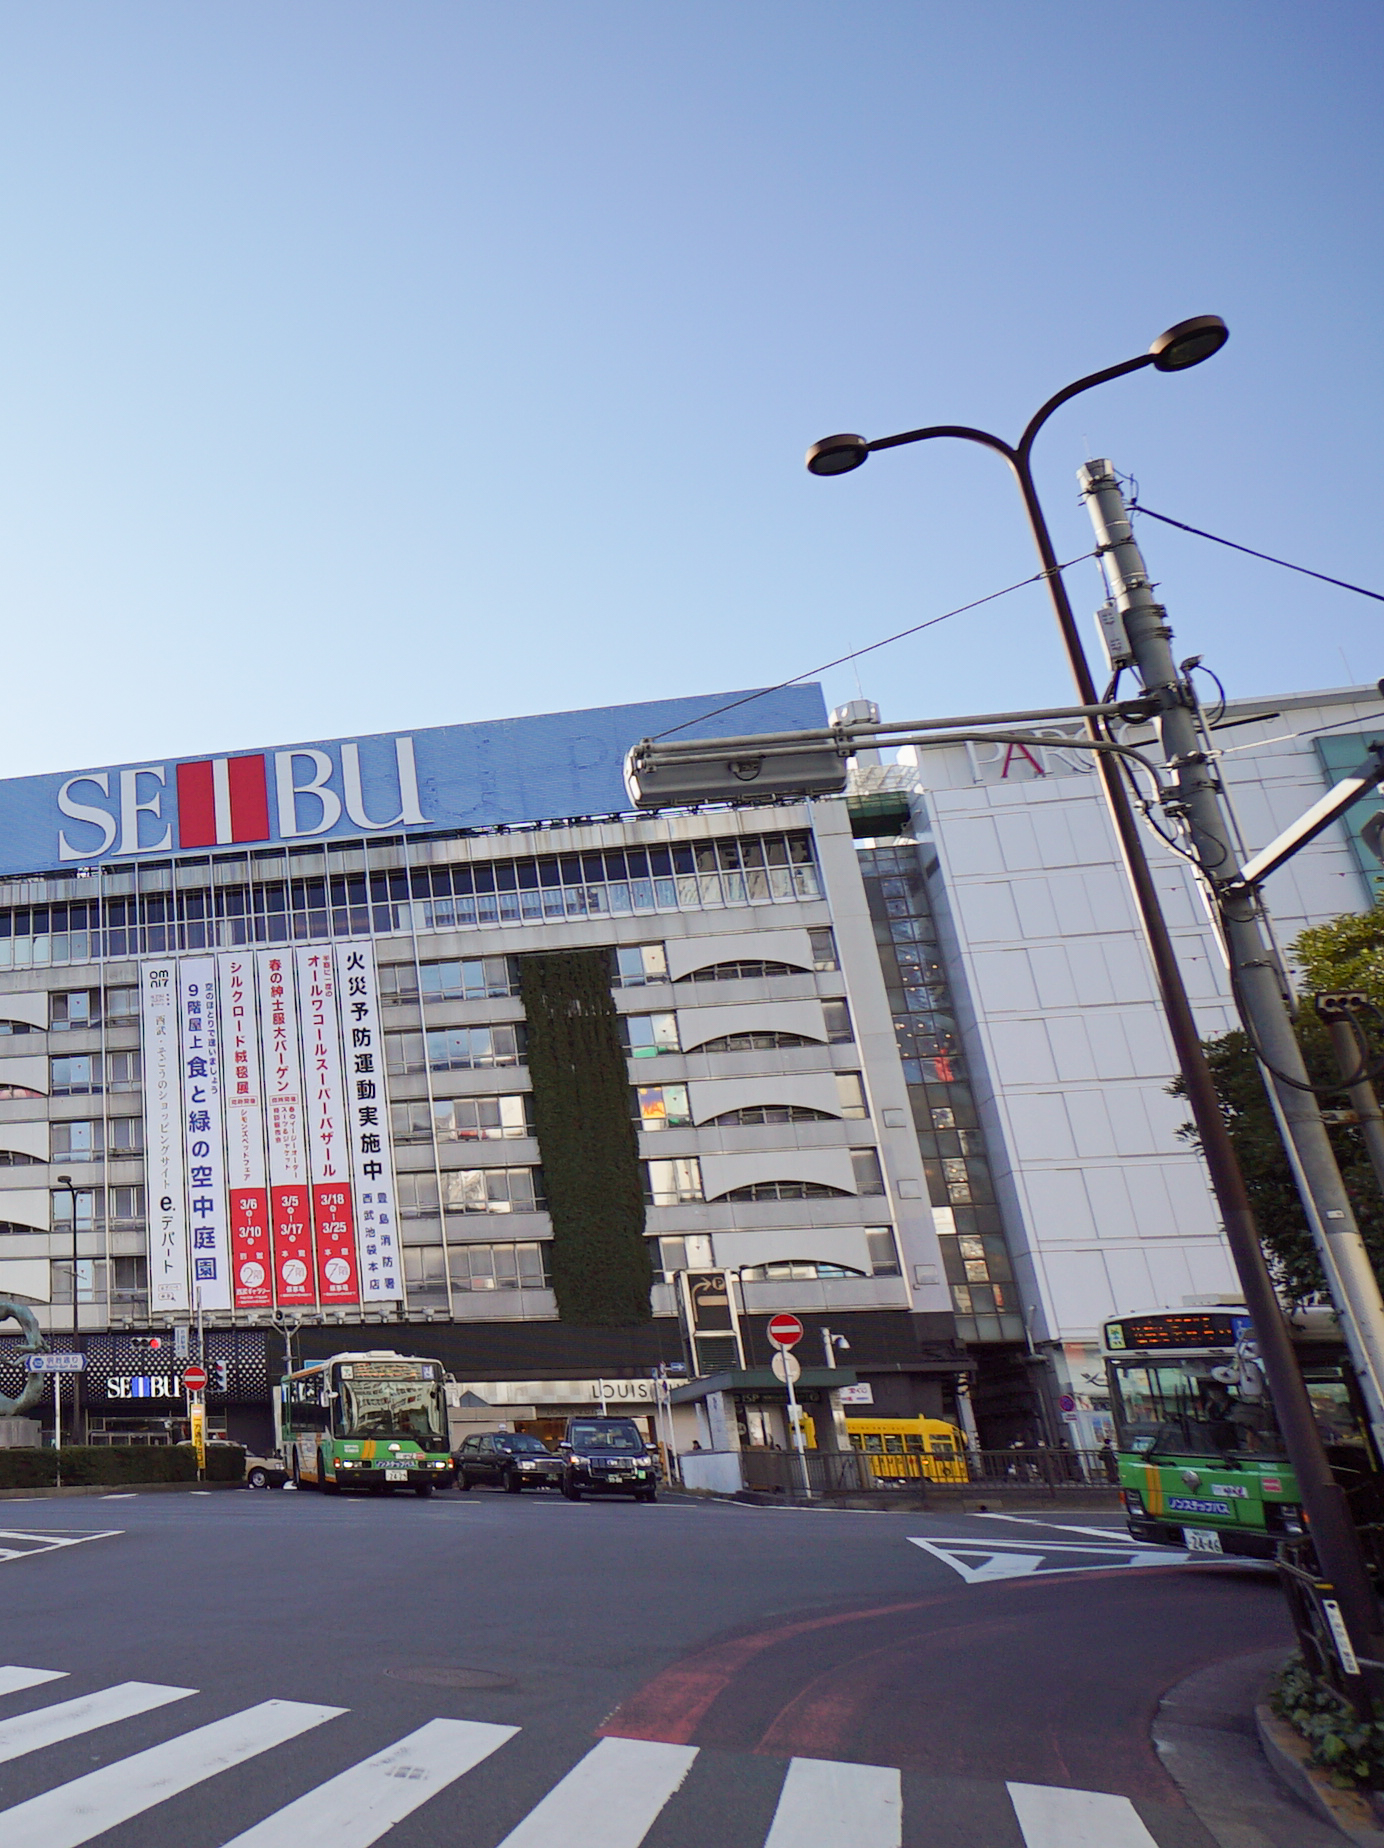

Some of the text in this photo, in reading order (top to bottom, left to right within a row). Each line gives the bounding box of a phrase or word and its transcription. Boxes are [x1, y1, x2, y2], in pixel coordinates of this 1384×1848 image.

[57, 736, 435, 861] SEIBU
[268, 958, 291, 1093] 春の紳士服大バーゲン
[307, 954, 337, 1178] オールワコールスーパーバザール
[346, 951, 384, 1182] 火災予防運動実施中
[239, 1198, 258, 1211] 3/6
[281, 1195, 299, 1208] 3/5
[320, 1193, 345, 1206] 3/18
[238, 1226, 262, 1238] 3/10
[280, 1223, 304, 1236] 3/17
[322, 1221, 347, 1234] 3/25
[362, 1192, 380, 1290] 西武池袋本店
[377, 1192, 395, 1290] 豊島消防署
[107, 1375, 181, 1399] SEIBU
[592, 1383, 648, 1399] LOUIS
[1169, 1497, 1231, 1516] ノンステップバス
